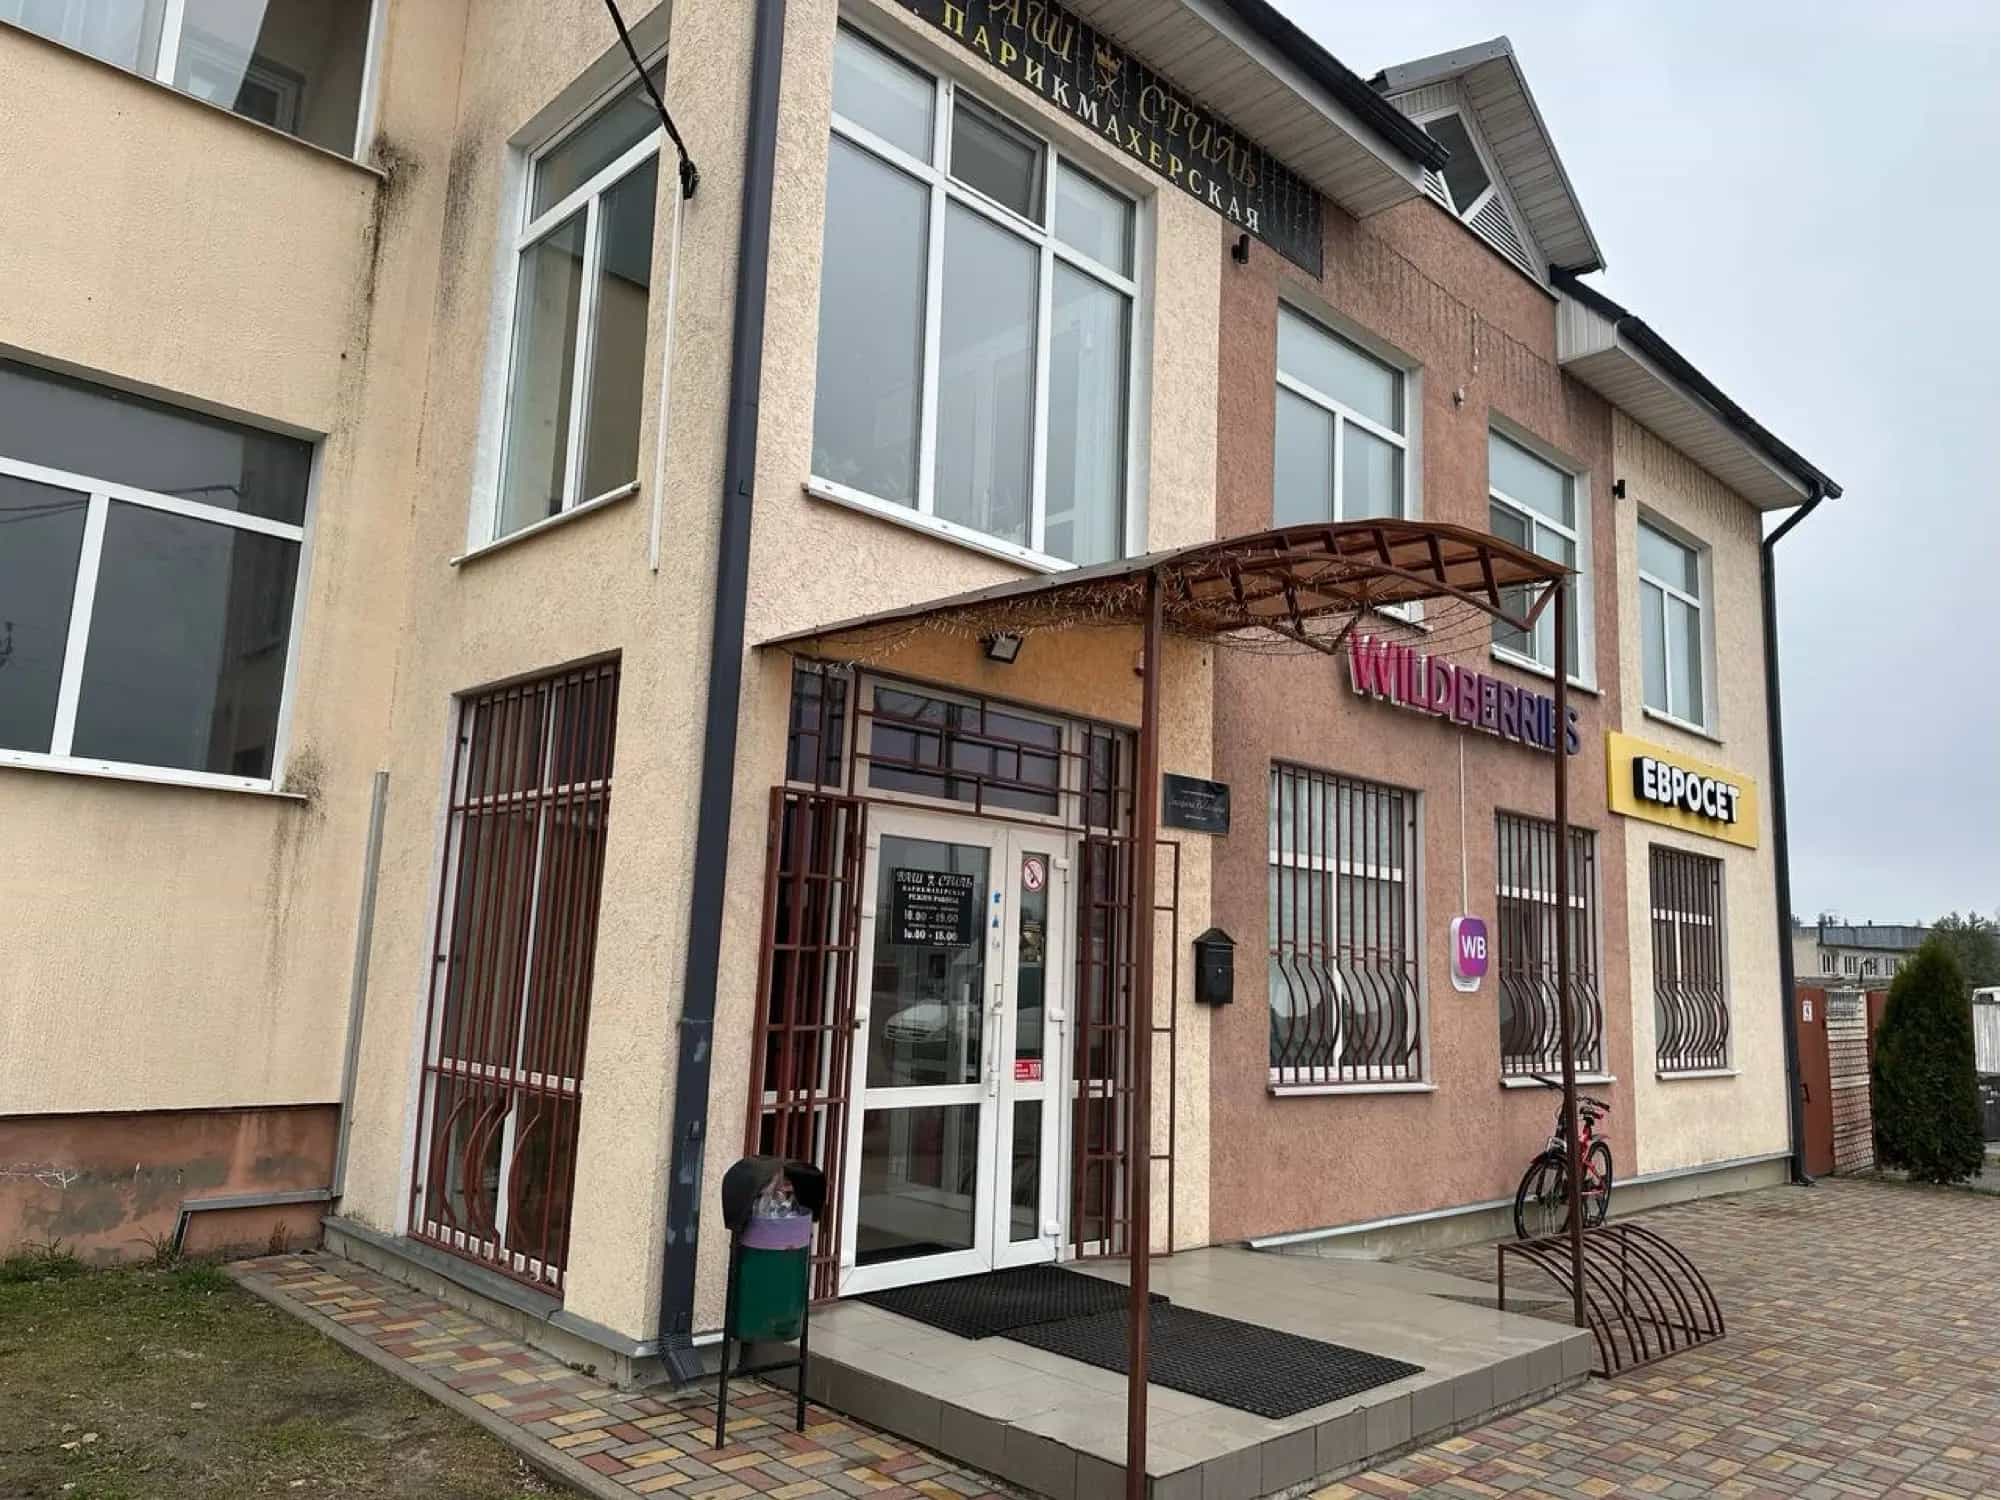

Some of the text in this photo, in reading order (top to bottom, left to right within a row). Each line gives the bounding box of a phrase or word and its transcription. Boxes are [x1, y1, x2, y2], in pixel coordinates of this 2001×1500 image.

[942, 0, 1260, 233] ПАРИКМАХЕРСКАЯ
[1139, 84, 1257, 188] СТИЛЬ
[1636, 757, 1740, 823] ЕВРОСЕТ
[1462, 935, 1486, 959] WB
